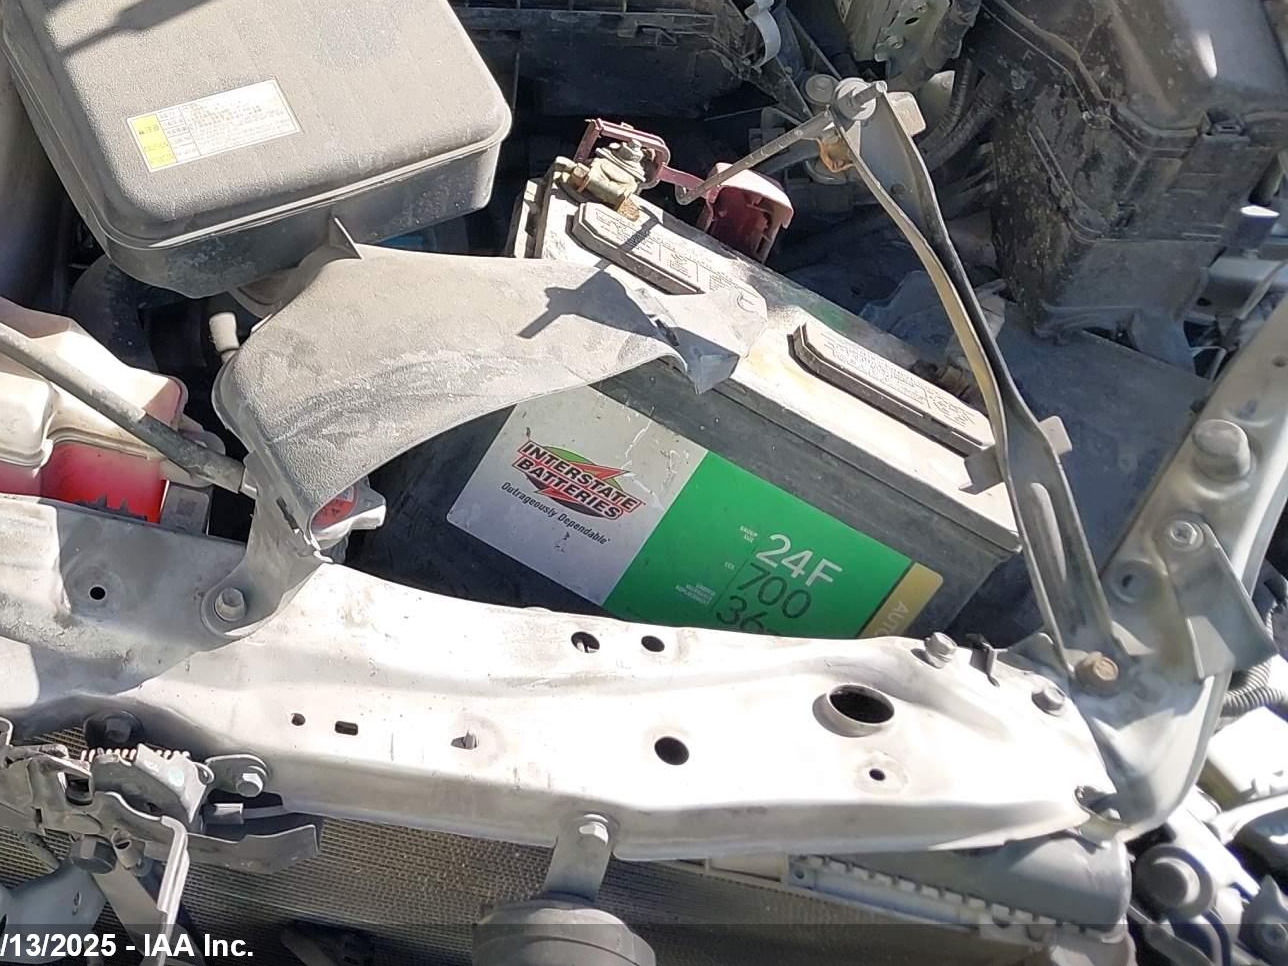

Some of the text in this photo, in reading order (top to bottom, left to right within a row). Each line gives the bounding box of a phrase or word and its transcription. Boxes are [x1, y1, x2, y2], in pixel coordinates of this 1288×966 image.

[516, 458, 621, 519] BATTERIES
[522, 443, 638, 510] INTERSTATE
[501, 481, 608, 545] Outrageously Dependable
[738, 562, 811, 619] 700
[755, 533, 843, 587] 24F
